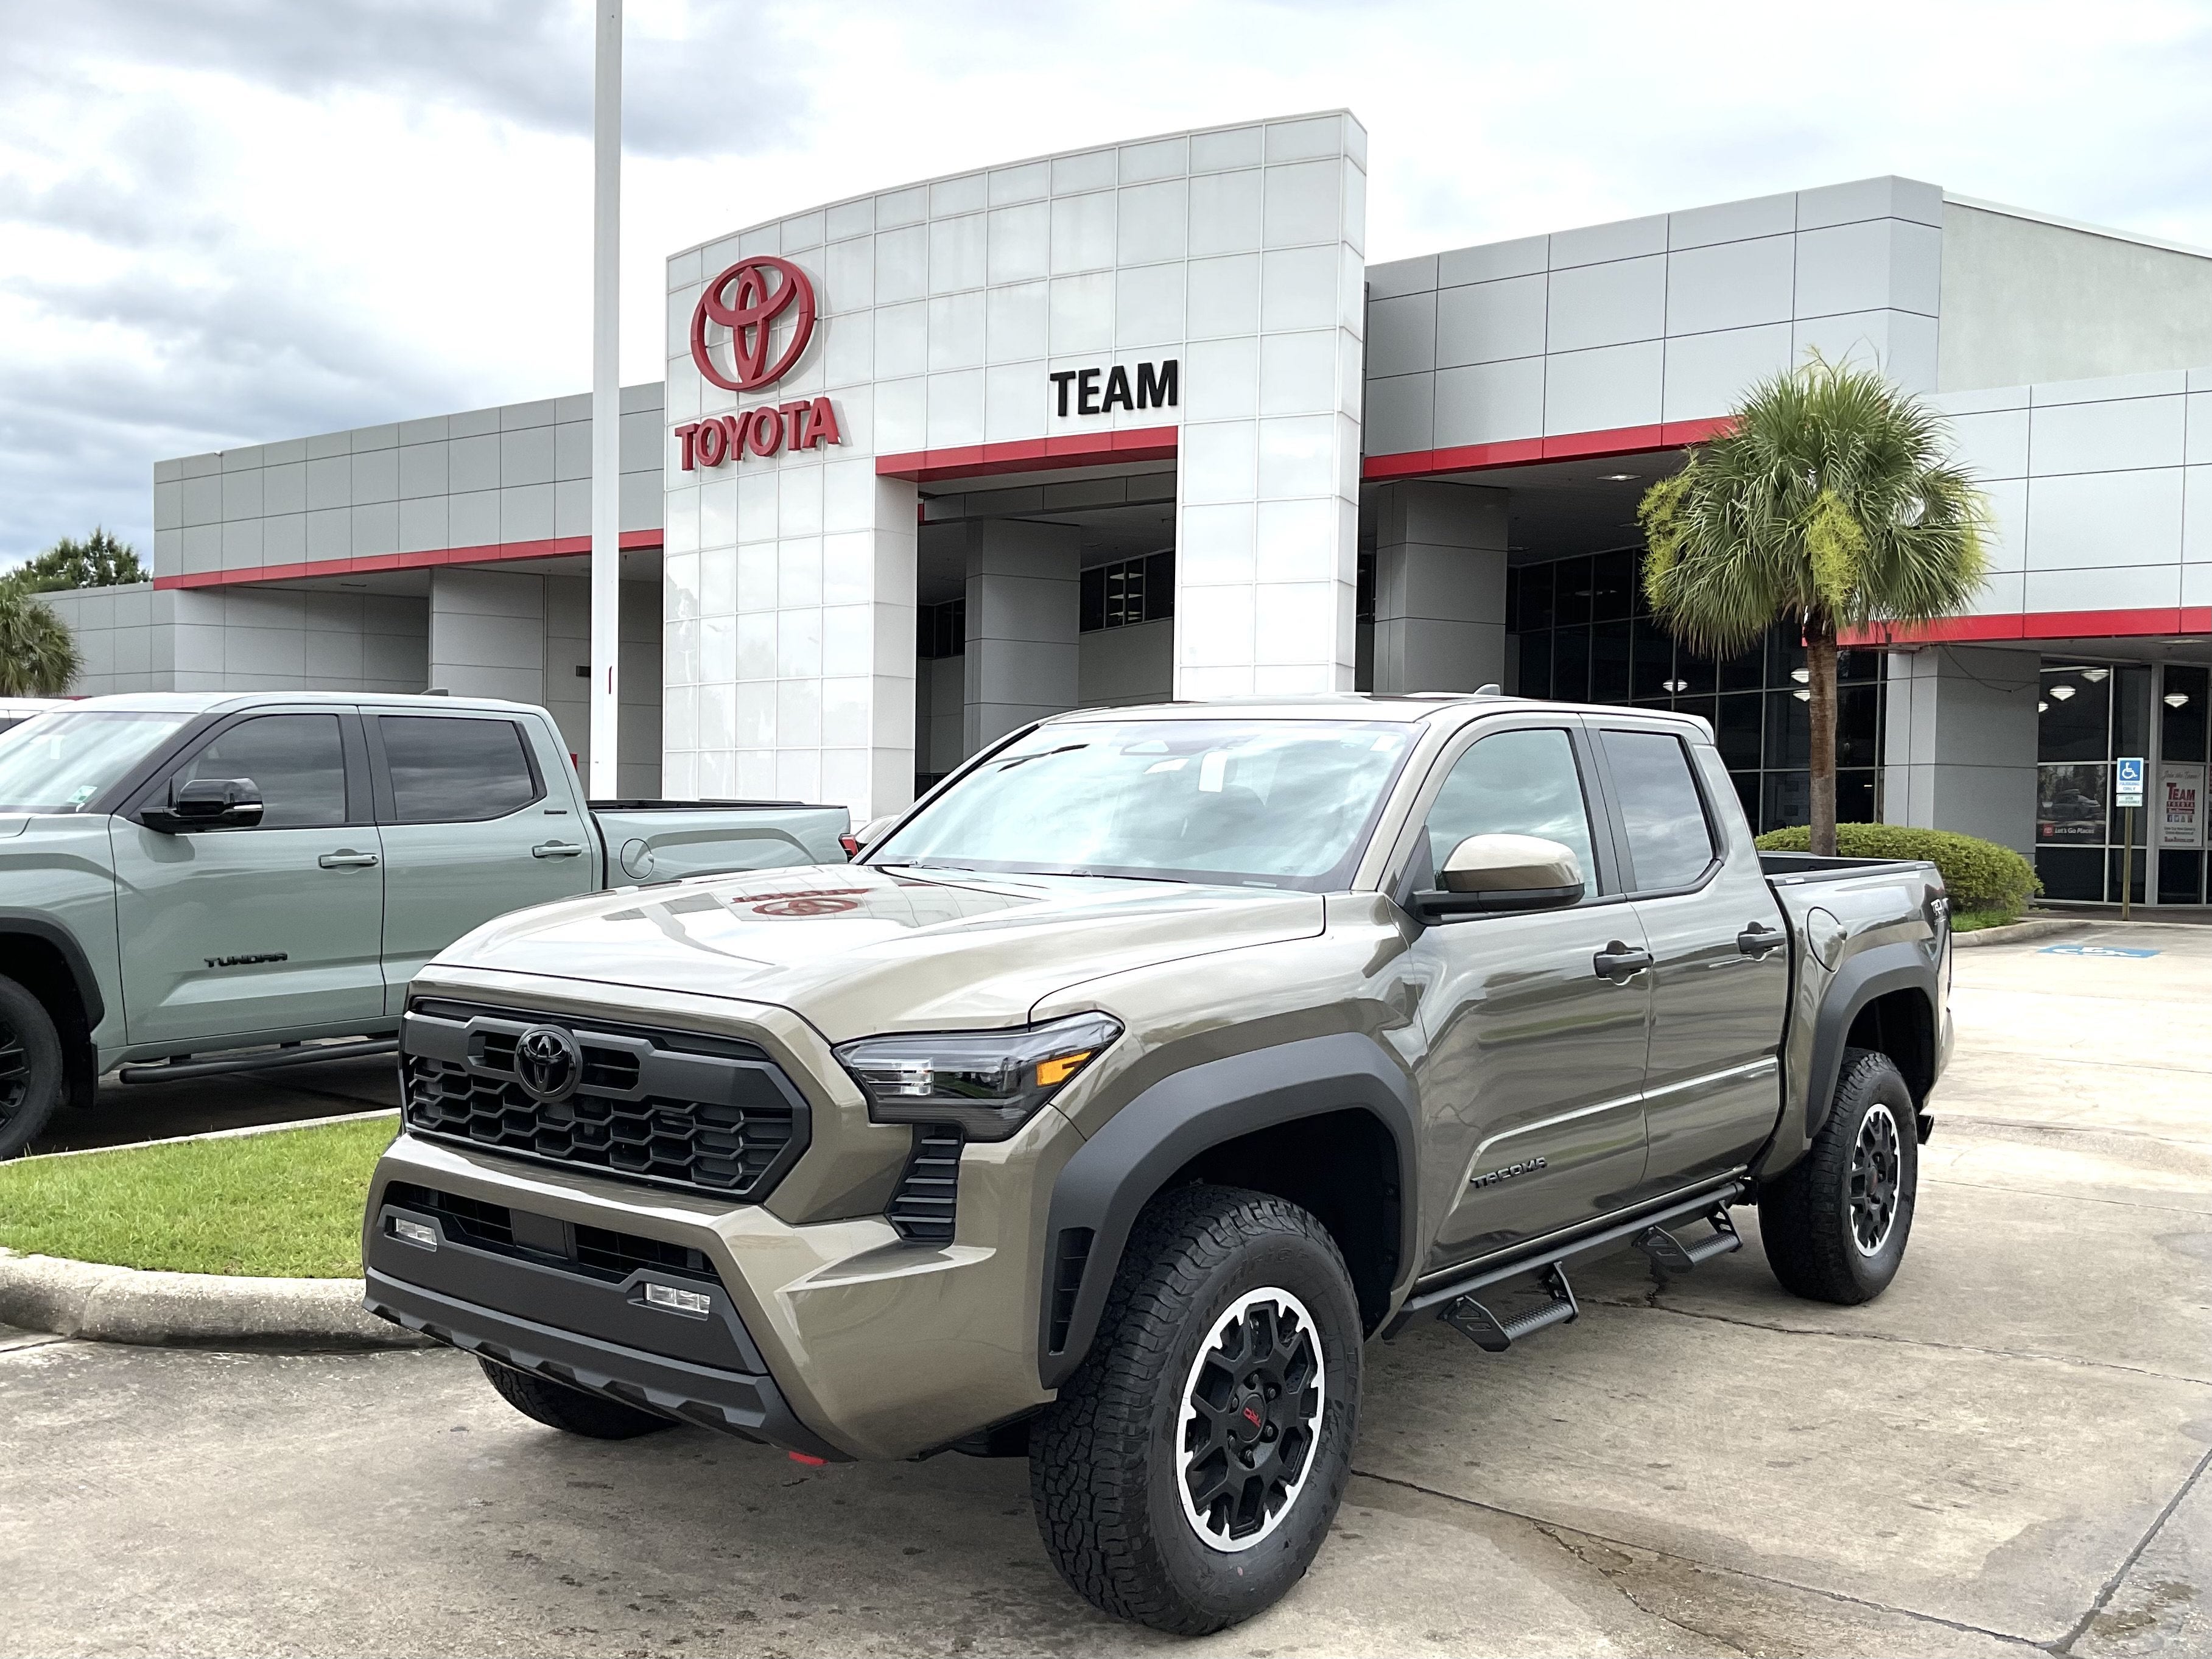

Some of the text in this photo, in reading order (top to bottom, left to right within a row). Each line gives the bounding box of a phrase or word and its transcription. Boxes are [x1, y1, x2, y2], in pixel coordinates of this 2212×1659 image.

[1050, 359, 1178, 416] TEAM
[675, 397, 841, 471] TOYOTA
[204, 951, 288, 968] TUNDRA
[1470, 1157, 1548, 1188] TACOMA
